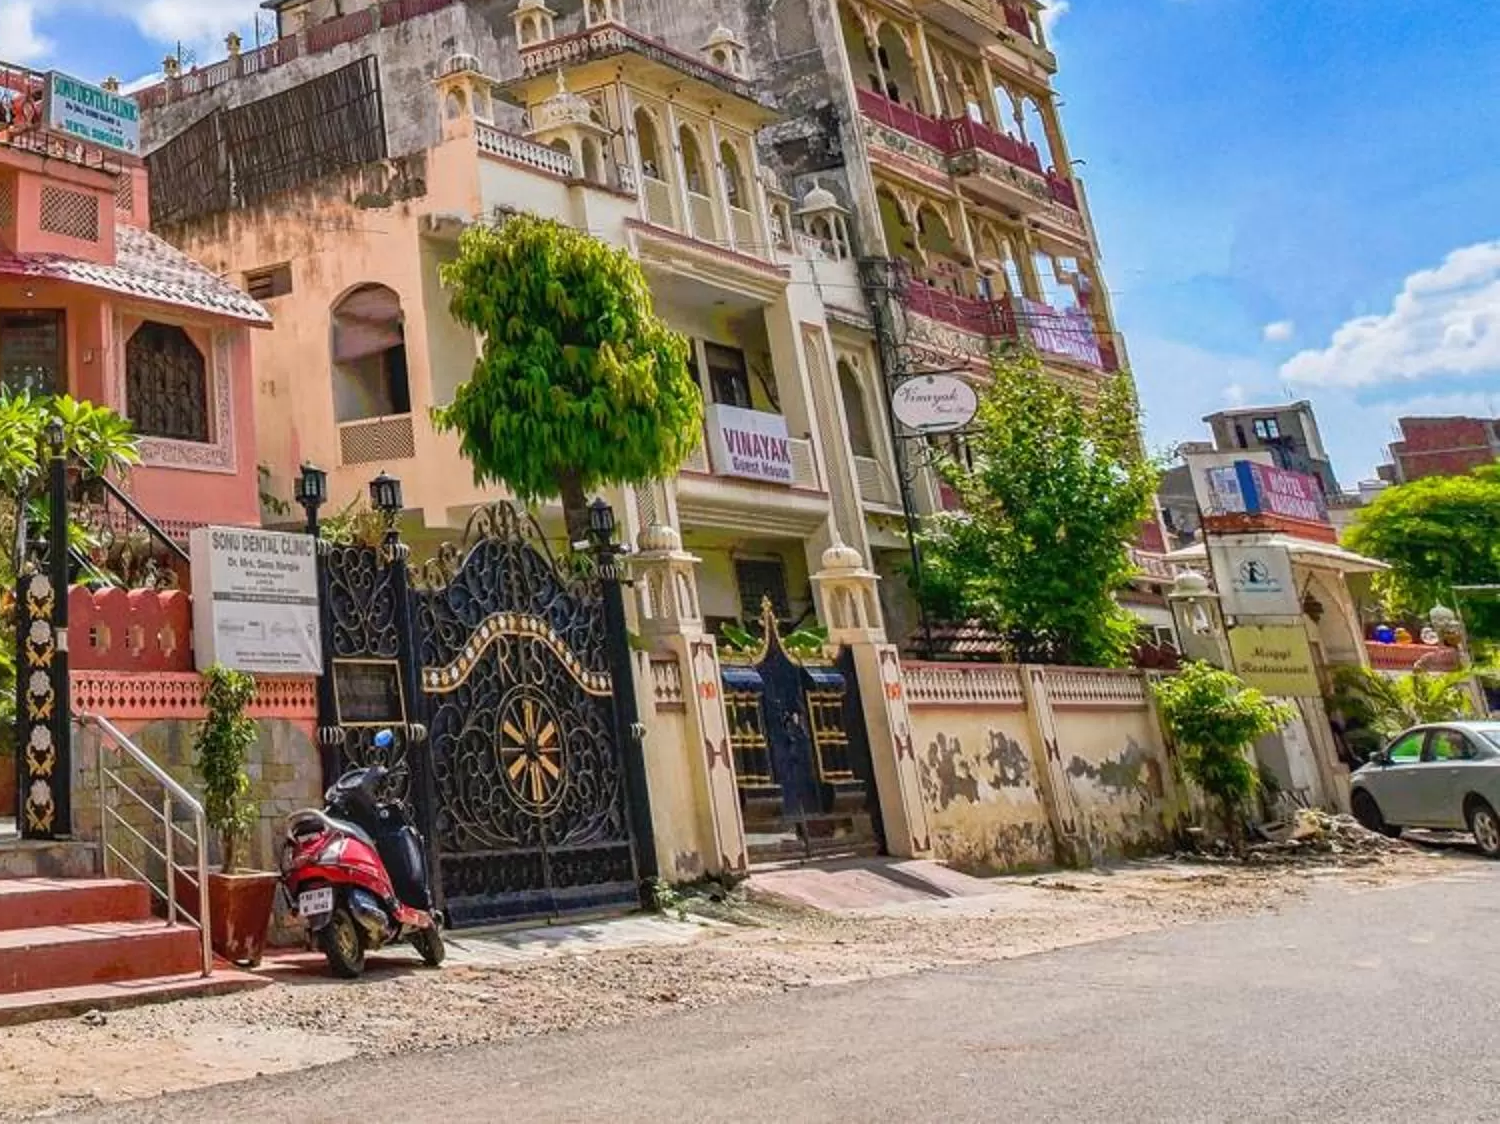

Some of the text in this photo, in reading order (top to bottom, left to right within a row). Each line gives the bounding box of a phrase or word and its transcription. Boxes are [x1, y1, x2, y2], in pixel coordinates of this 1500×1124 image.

[898, 386, 959, 408] Vinayak
[723, 428, 791, 464] VINAYAK
[732, 456, 790, 479] Guest House
[212, 531, 312, 557] SONU DENTAL CLINIC
